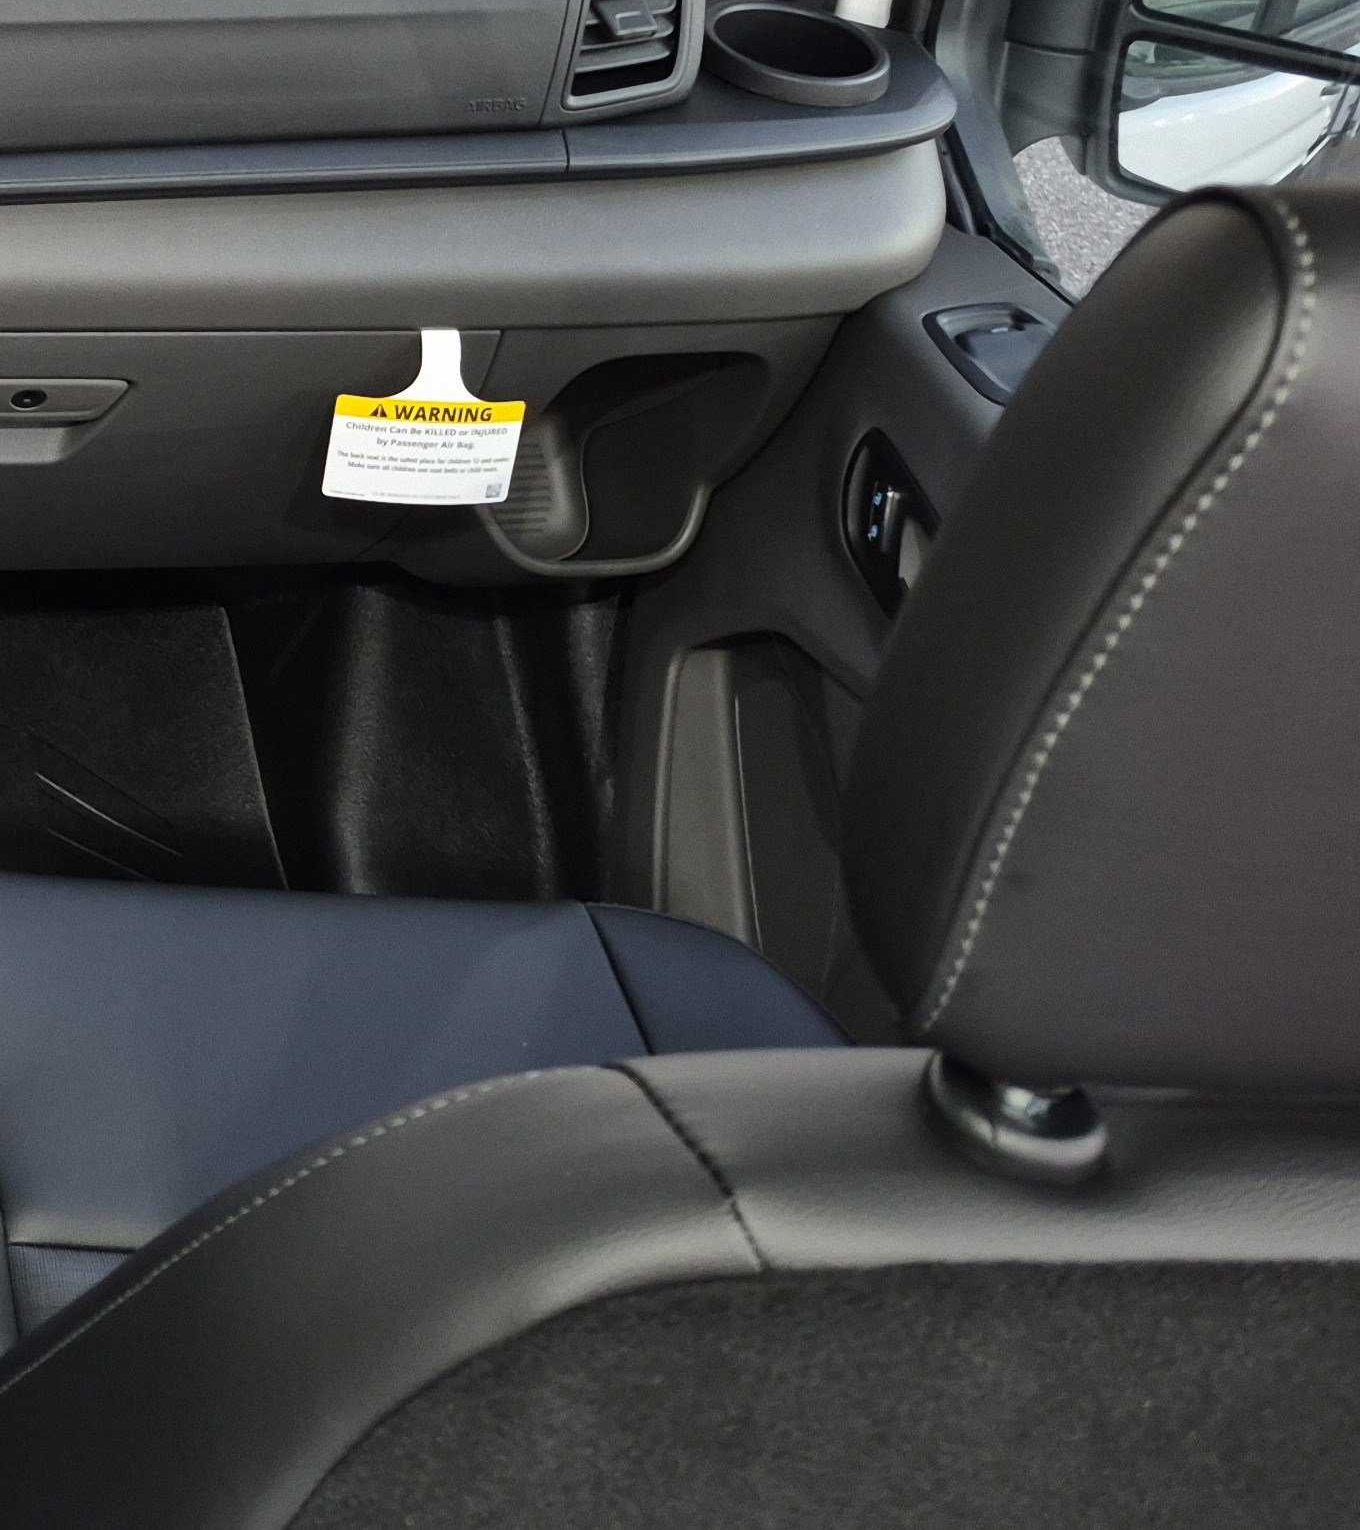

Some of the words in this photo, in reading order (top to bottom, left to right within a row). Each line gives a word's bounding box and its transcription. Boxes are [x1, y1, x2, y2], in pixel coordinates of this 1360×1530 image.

[394, 405, 493, 423] WARNING
[346, 421, 387, 433] Children
[389, 426, 408, 435] Can
[410, 427, 422, 436] Be
[424, 428, 457, 437] KILLED
[471, 427, 508, 437] INJURED
[376, 437, 388, 447] by
[391, 439, 439, 451] Passenger
[441, 441, 455, 449] Air
